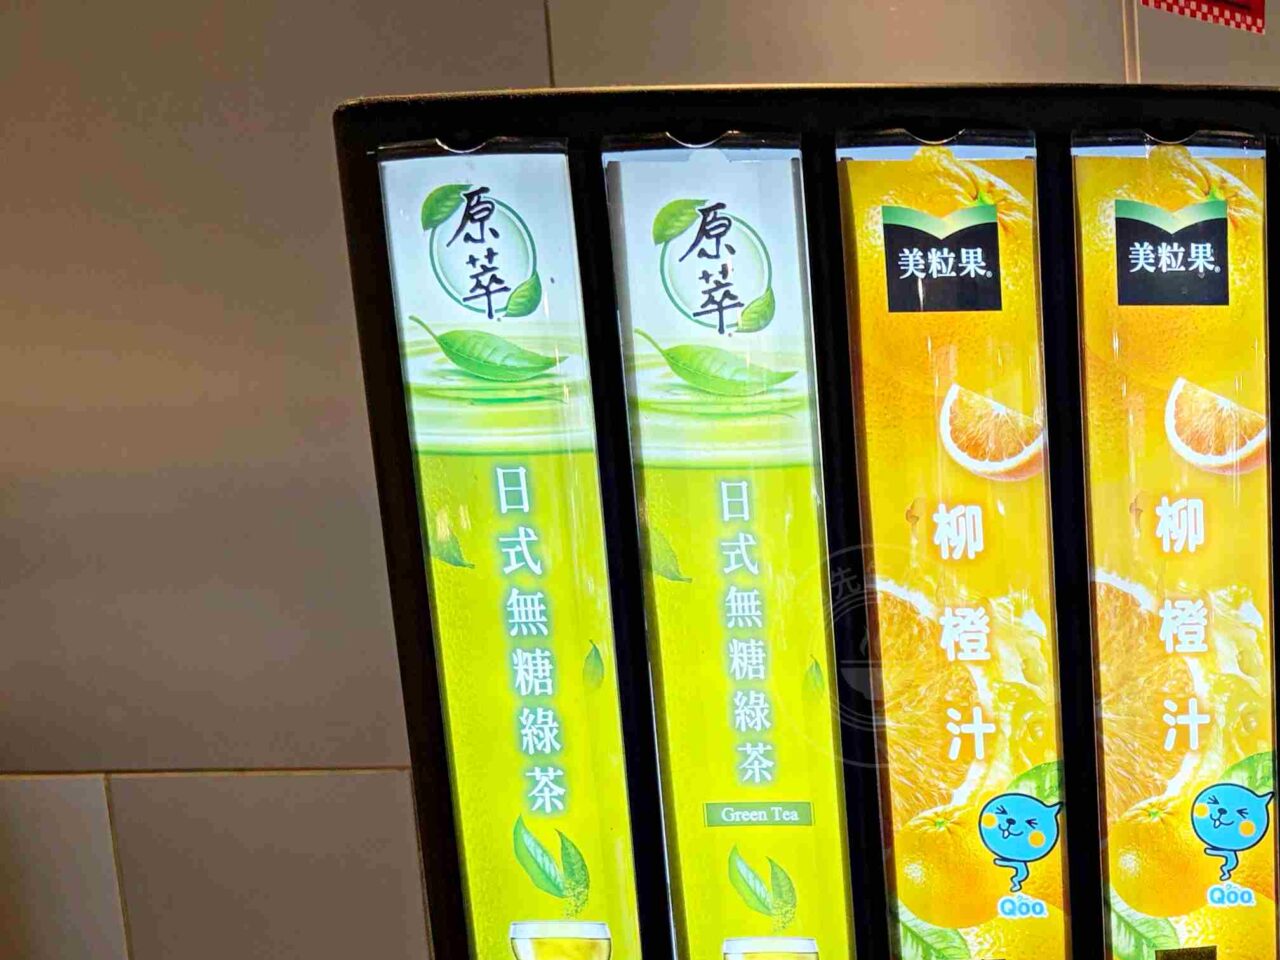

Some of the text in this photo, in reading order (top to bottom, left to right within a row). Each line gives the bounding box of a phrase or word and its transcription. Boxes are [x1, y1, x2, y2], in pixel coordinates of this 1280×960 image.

[446, 187, 511, 320] 原萃
[679, 202, 744, 334] 原萃
[897, 246, 988, 280] 美粒果
[1129, 240, 1215, 274] 美粒果
[495, 465, 568, 814] 日式無糖綠茶
[719, 480, 776, 784] 日式無糖綠茶
[932, 502, 996, 762] 柳橙汁
[1155, 495, 1212, 752] 柳橙汁
[721, 806, 800, 821] Green Tea
[998, 897, 1046, 917] Qoo
[1208, 886, 1254, 905] Qoo
